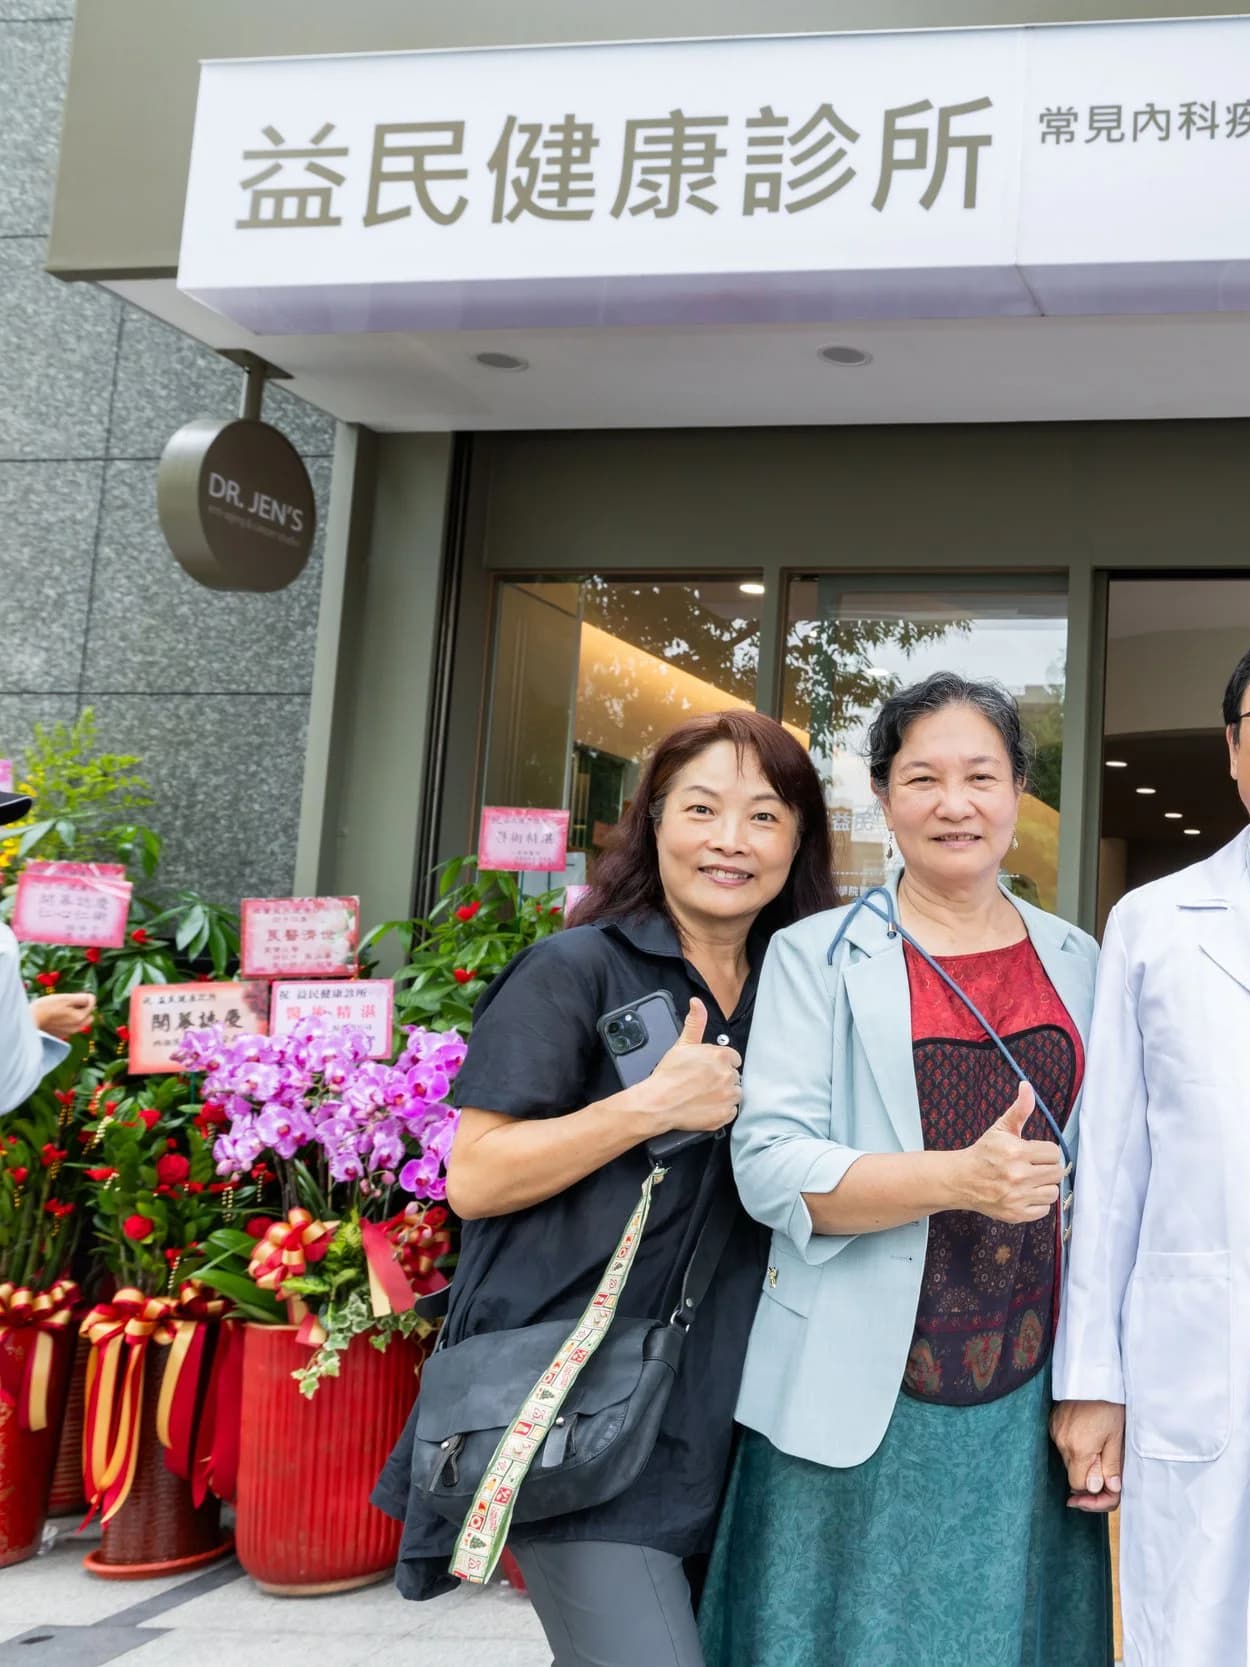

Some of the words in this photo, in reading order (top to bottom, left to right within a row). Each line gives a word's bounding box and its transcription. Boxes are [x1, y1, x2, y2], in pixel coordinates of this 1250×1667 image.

[235, 95, 994, 230] 益民健康診所
[208, 471, 244, 509] DR.
[247, 491, 304, 533] JEN'S
